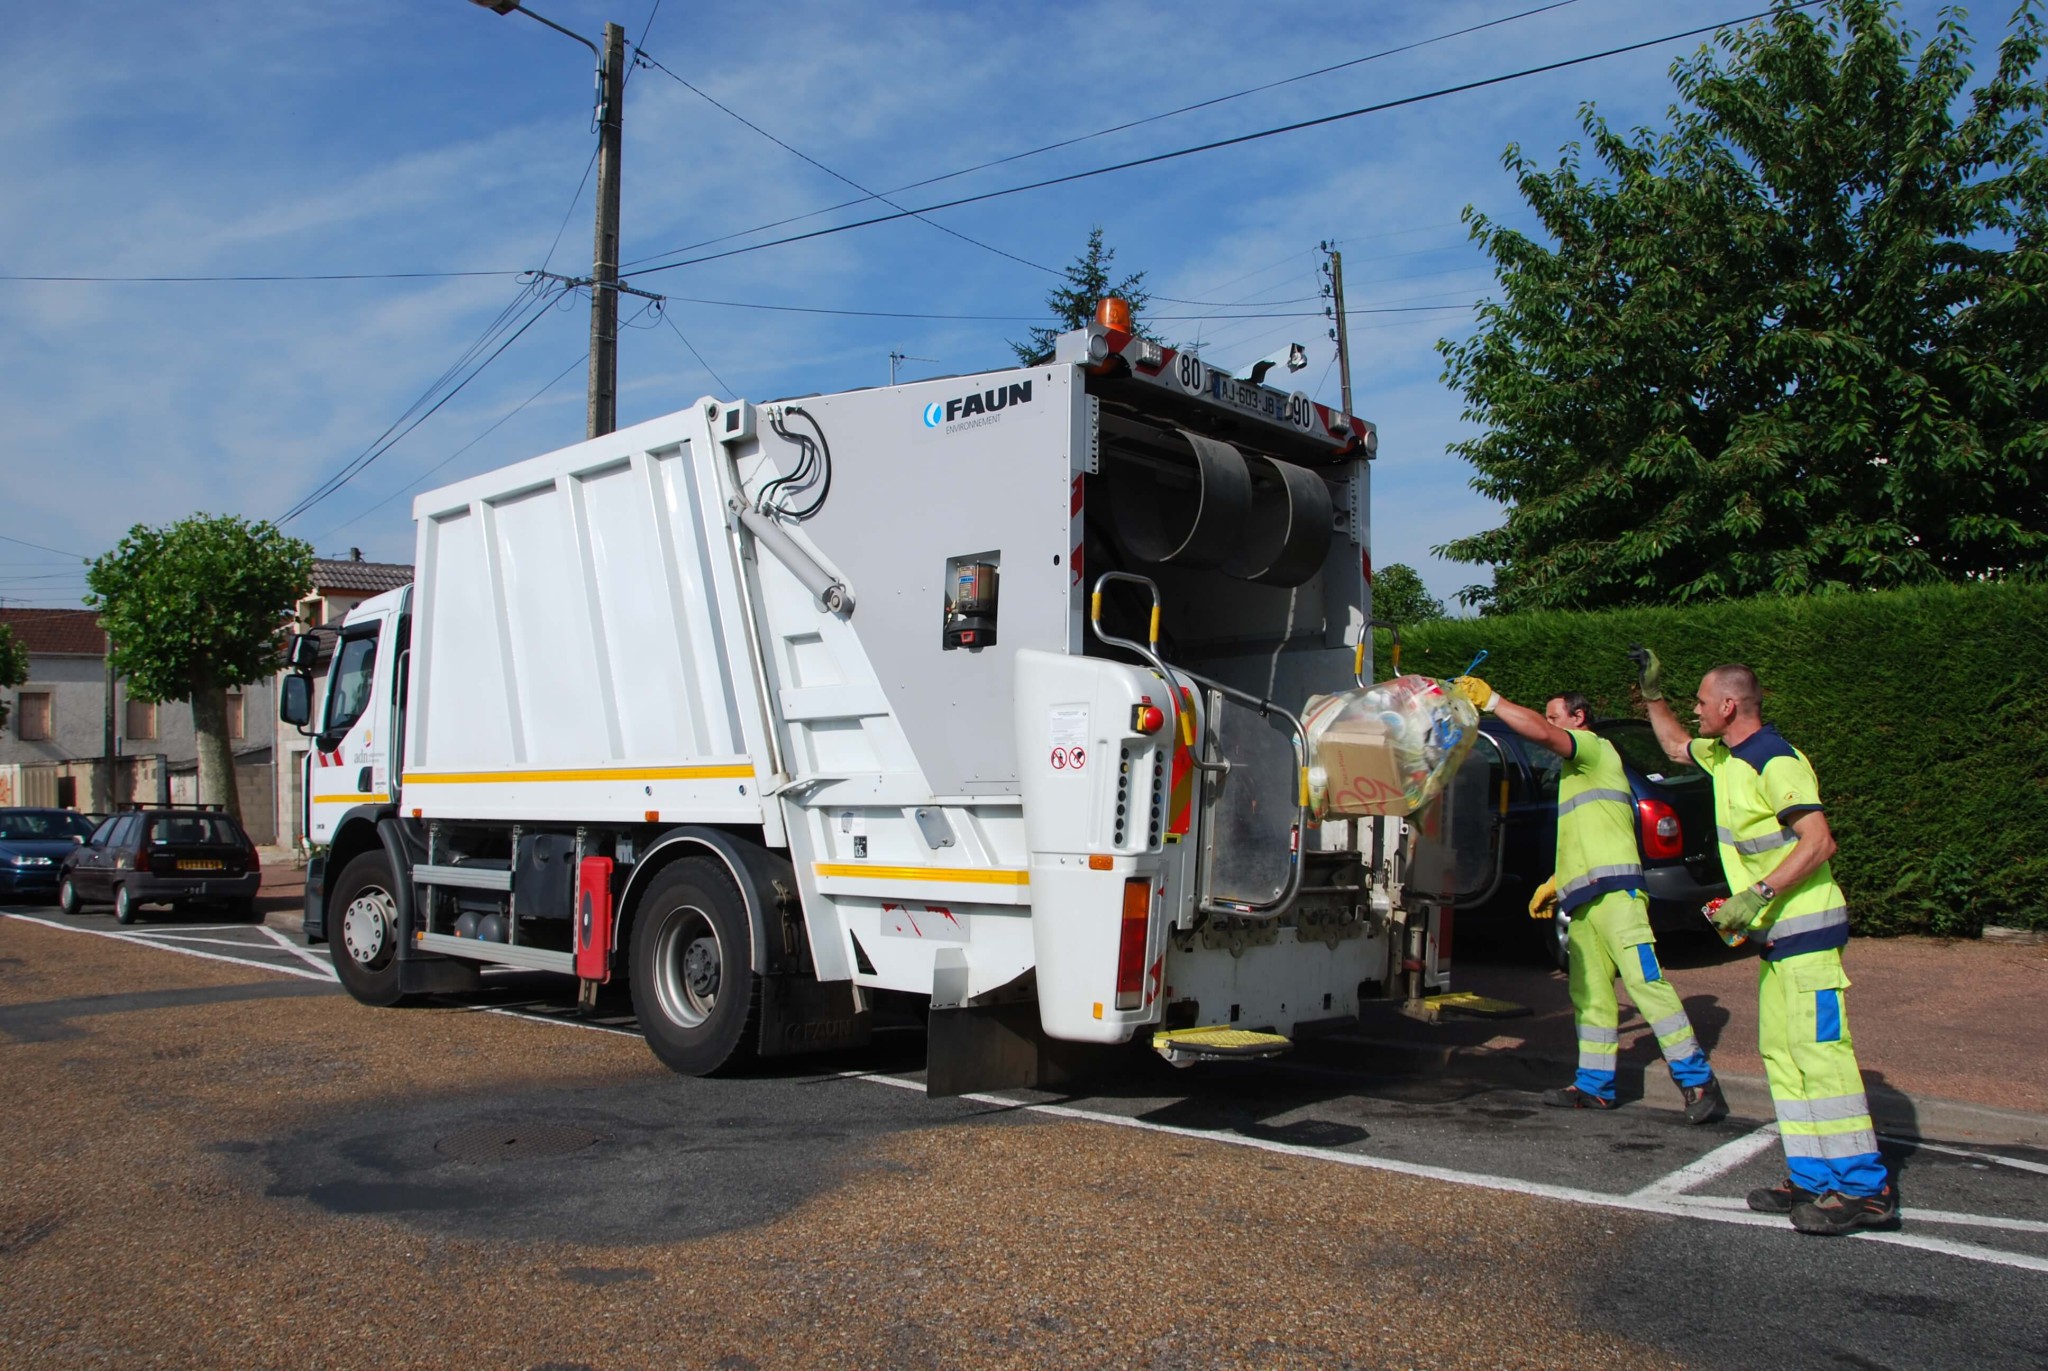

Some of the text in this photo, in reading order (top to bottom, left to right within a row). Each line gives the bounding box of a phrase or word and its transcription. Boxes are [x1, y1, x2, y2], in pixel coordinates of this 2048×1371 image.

[1181, 354, 1200, 390] 80
[946, 380, 1032, 422] FAUN
[1222, 380, 1274, 415] AJ-603-JB
[1293, 396, 1309, 428] 90
[946, 413, 1001, 435] ENVIRONNEMENT
[804, 1019, 854, 1041] FAUN
